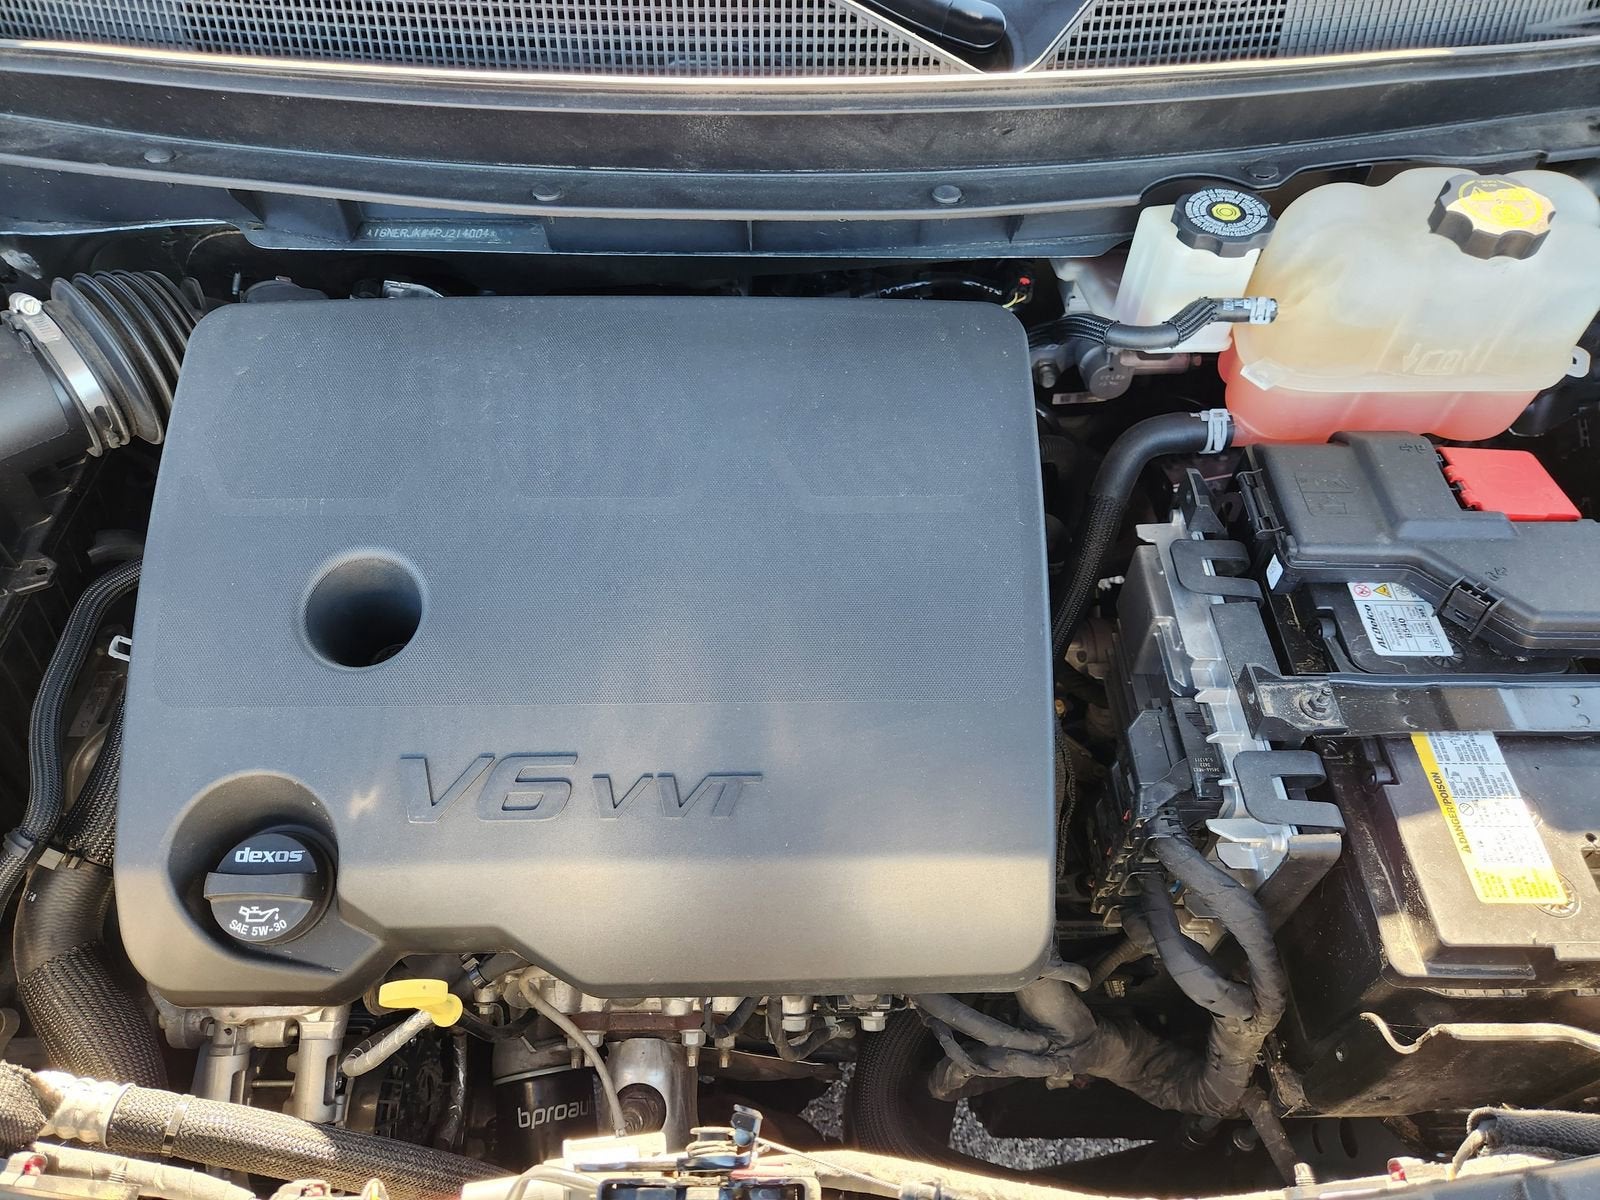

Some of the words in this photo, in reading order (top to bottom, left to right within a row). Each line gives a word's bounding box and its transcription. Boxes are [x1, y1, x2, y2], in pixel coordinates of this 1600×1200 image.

[1364, 604, 1388, 649] ACDelco
[399, 751, 578, 824] V6
[592, 771, 763, 820] VVT
[235, 847, 304, 863] dexos
[229, 919, 249, 935] SAE
[252, 919, 287, 936] 5W-30
